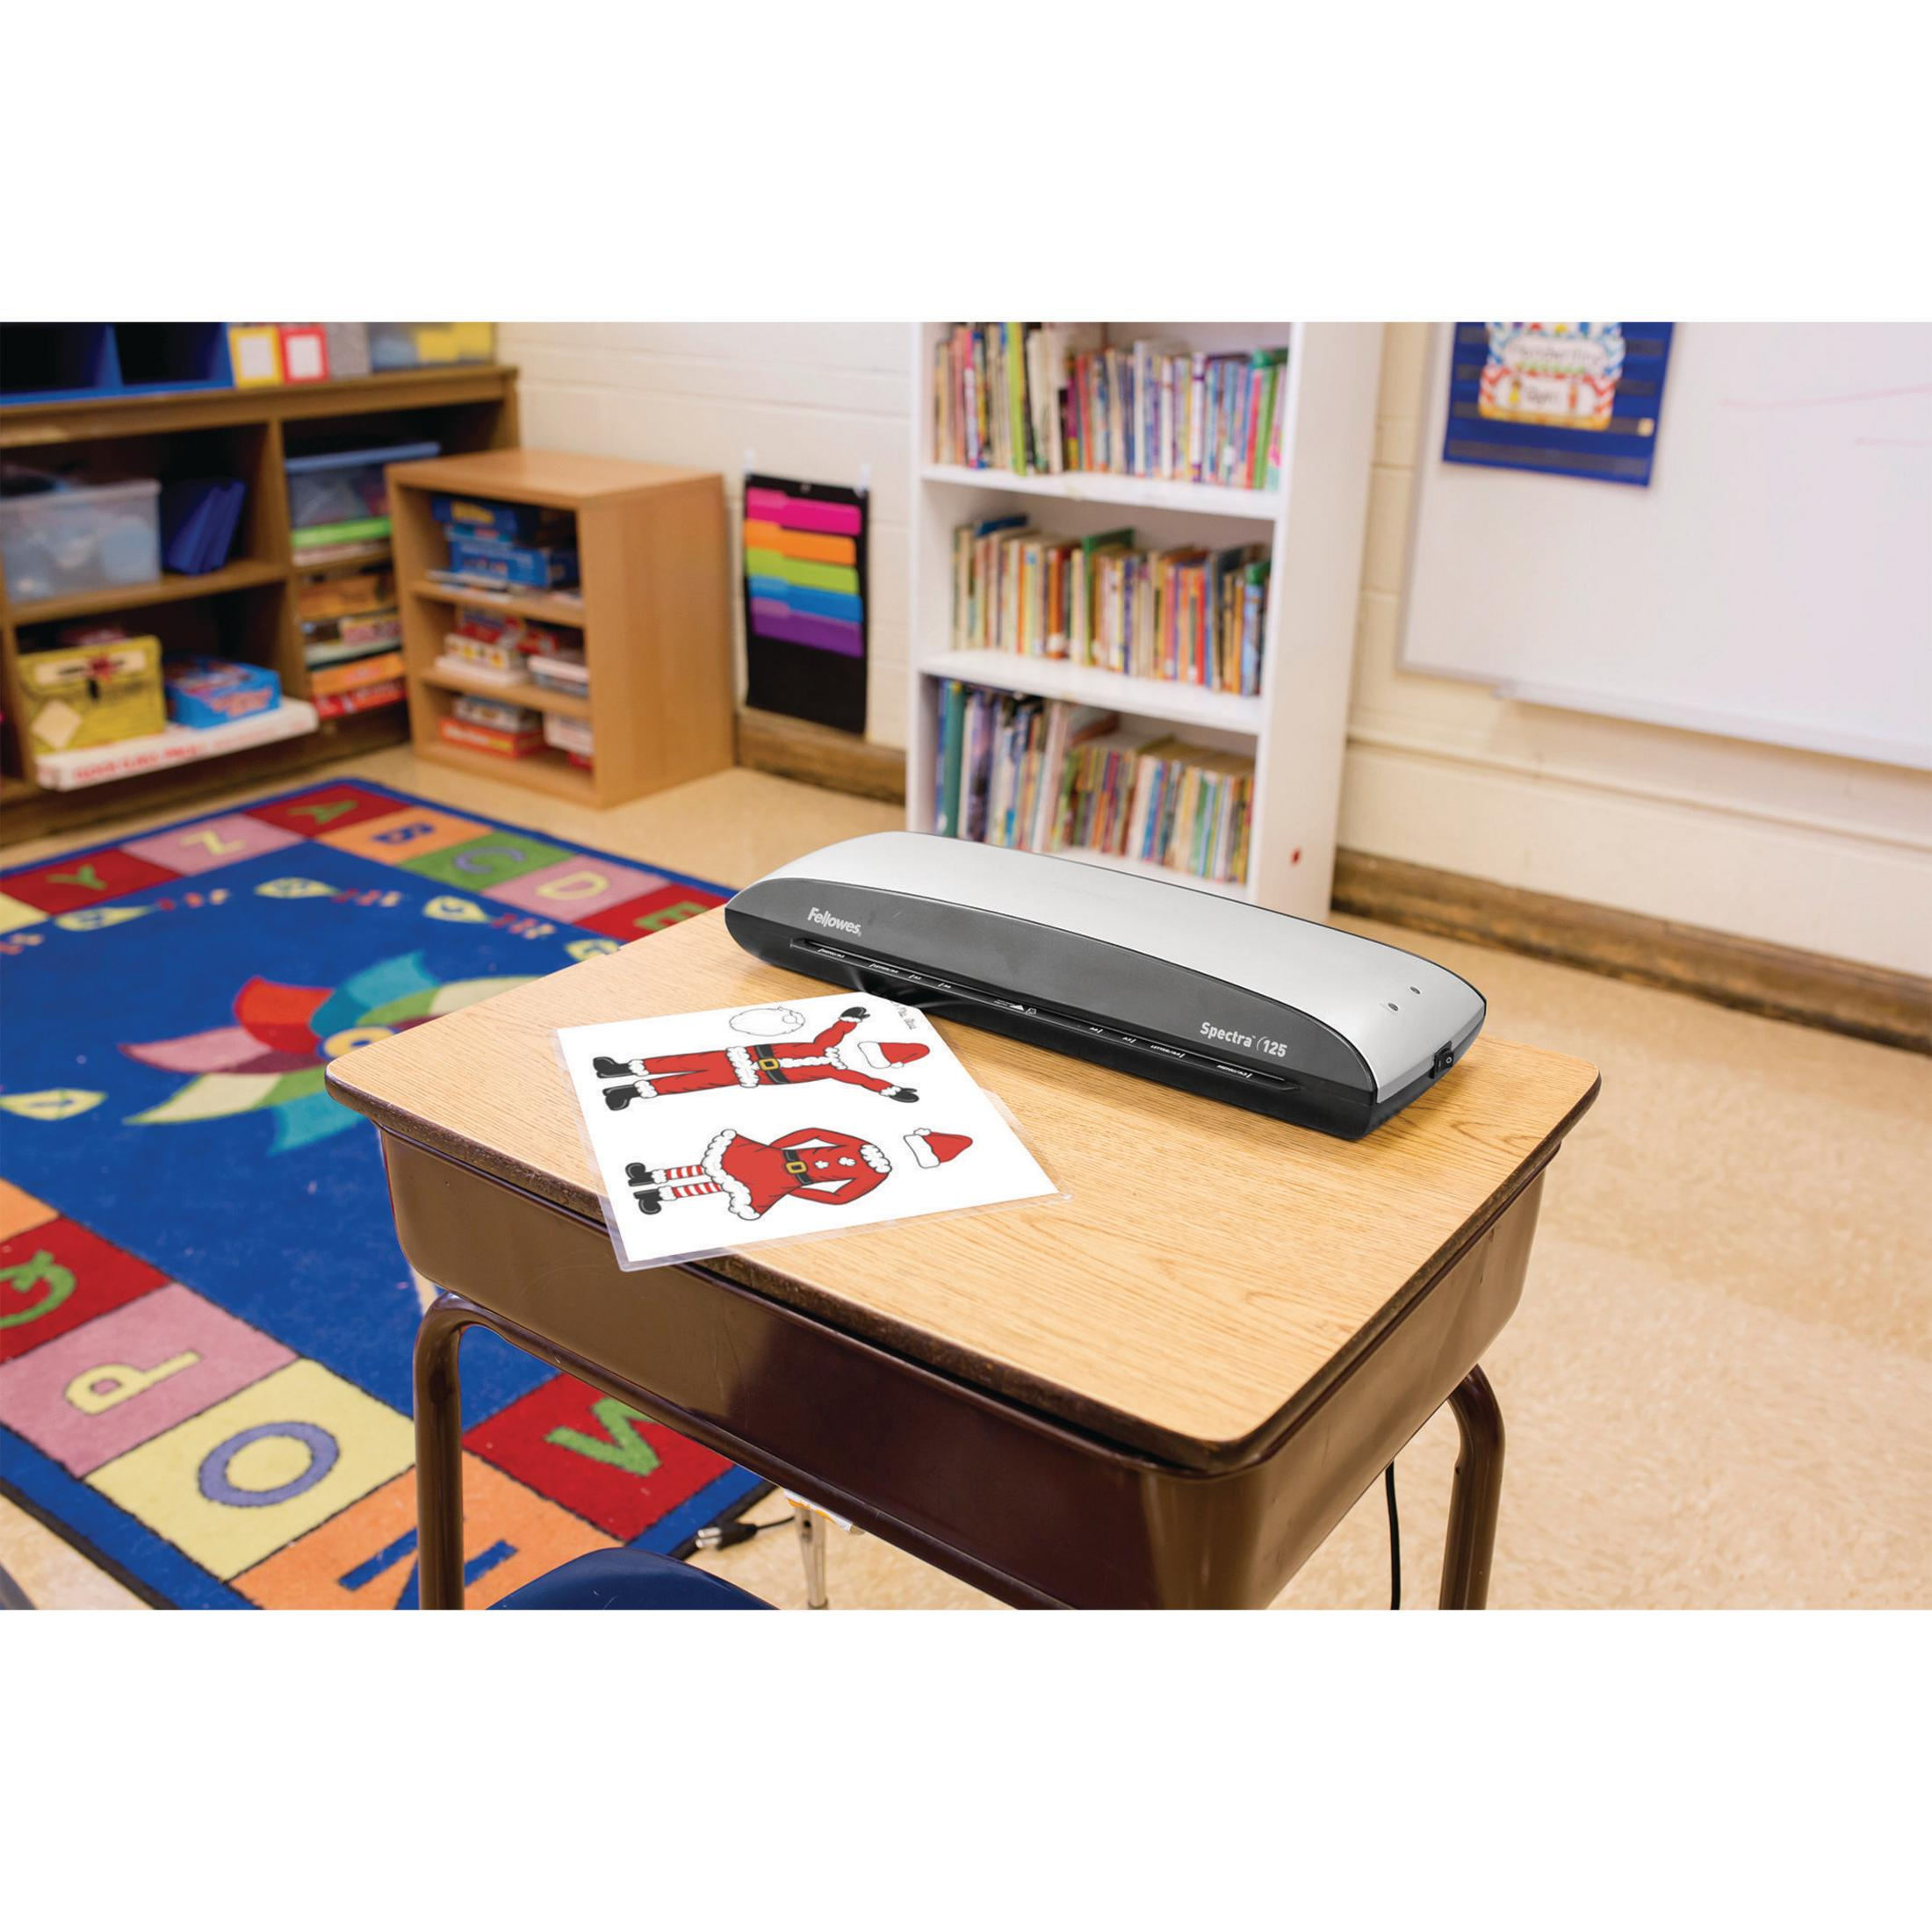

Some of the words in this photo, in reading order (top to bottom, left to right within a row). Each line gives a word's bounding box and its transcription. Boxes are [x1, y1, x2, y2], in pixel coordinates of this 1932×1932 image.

[372, 823, 436, 845] B
[454, 847, 524, 875] C
[535, 871, 609, 900] D
[807, 906, 861, 934] Fellowes
[1200, 1021, 1253, 1048] Spectra
[1262, 1039, 1288, 1057] 125
[64, 1350, 203, 1416] P
[198, 1420, 341, 1508] O
